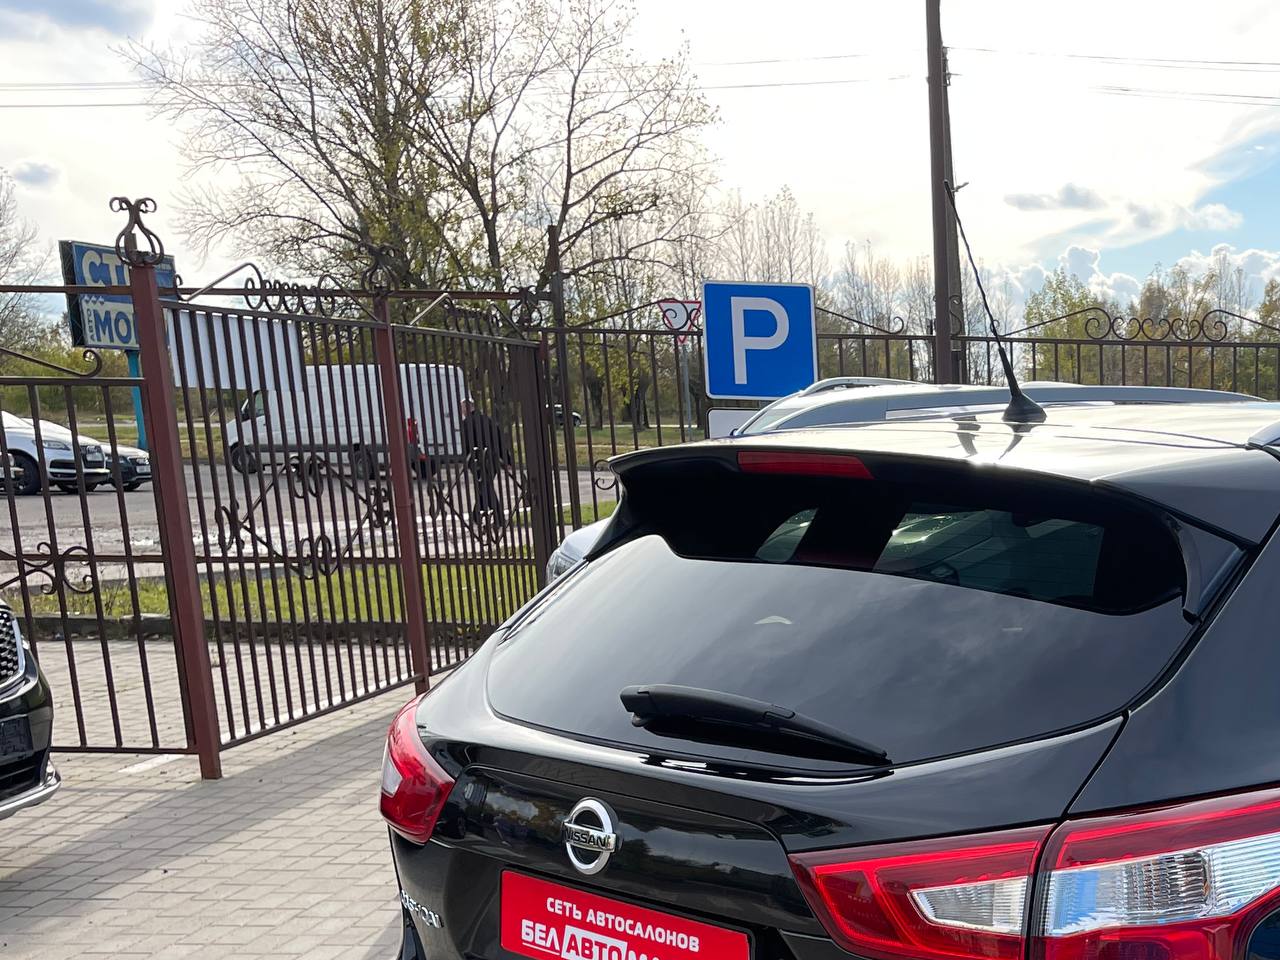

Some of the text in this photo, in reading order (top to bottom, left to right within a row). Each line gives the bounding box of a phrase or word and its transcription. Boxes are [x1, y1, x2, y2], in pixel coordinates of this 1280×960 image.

[730, 296, 790, 385] P
[565, 827, 609, 848] NISSAN
[546, 897, 700, 952] СЕТЬ АВТОСАЛОНОВ
